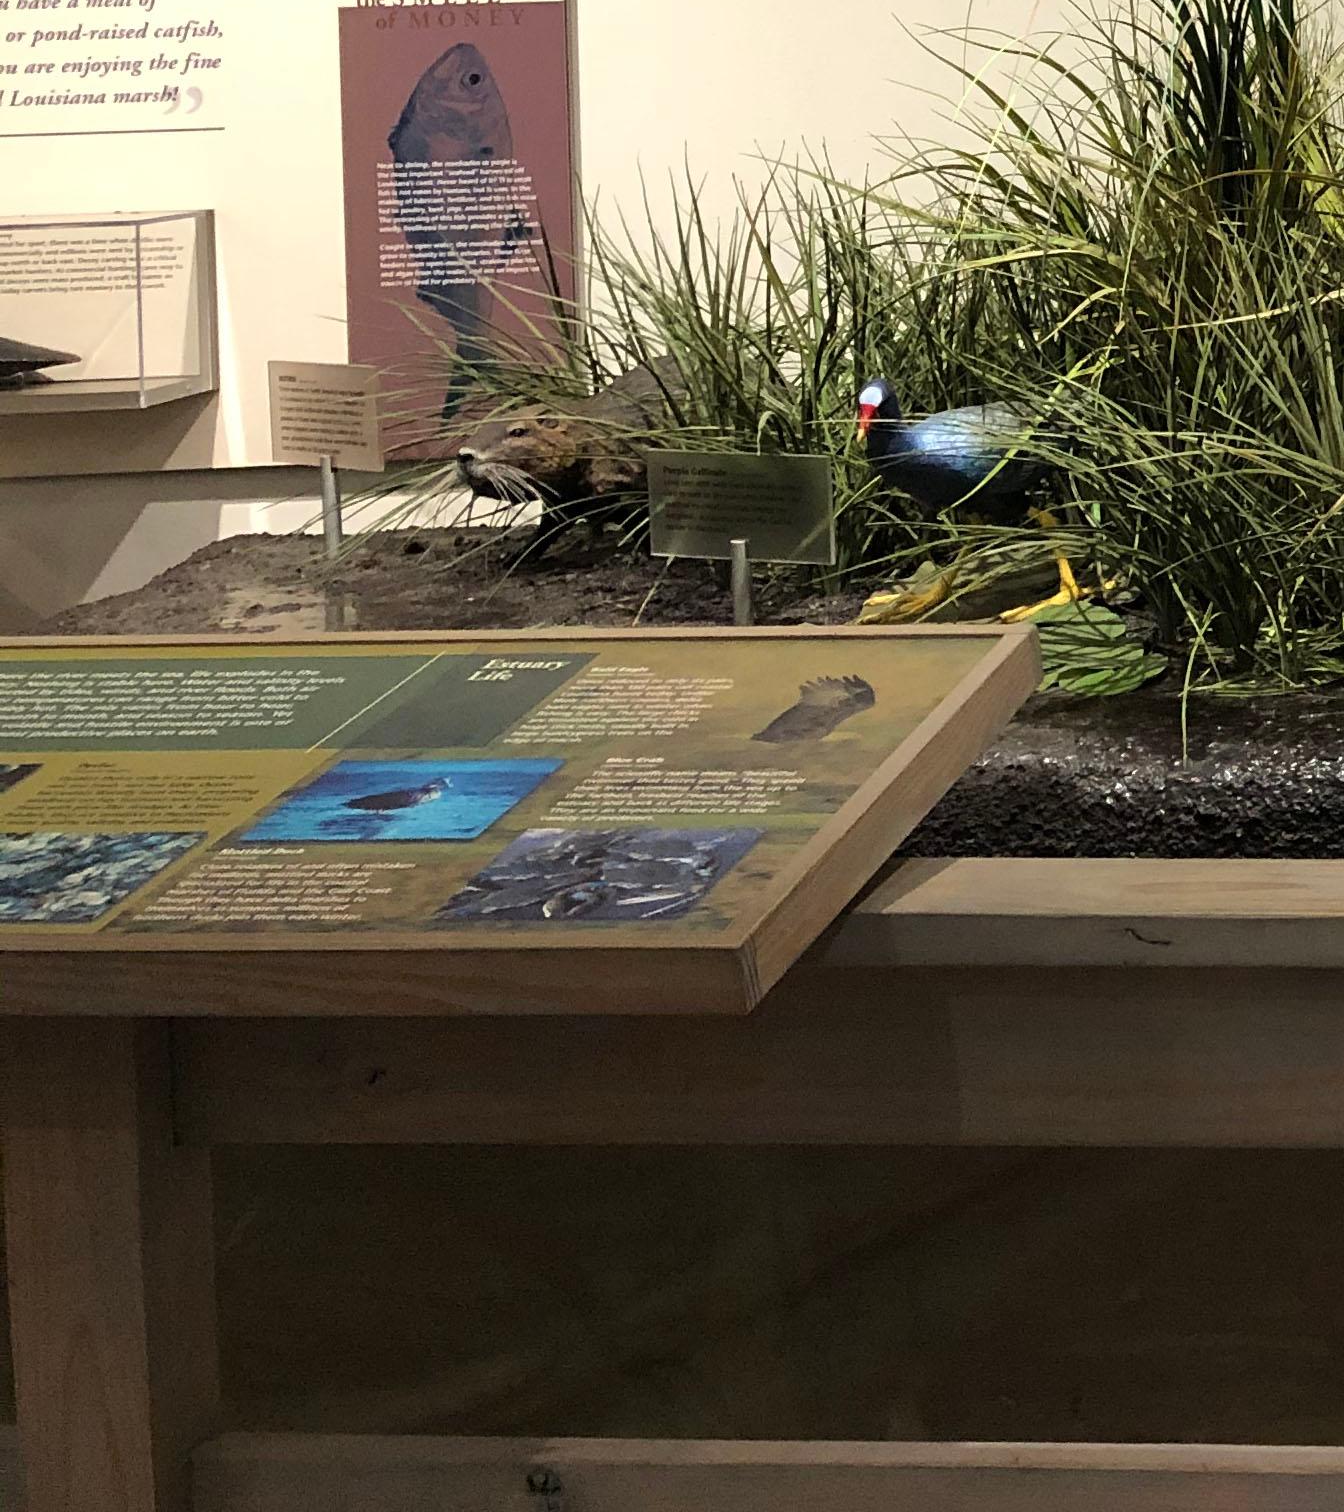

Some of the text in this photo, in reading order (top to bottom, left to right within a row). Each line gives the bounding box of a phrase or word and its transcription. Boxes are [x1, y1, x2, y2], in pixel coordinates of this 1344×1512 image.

[376, 9, 525, 29] of MONEY
[6, 20, 223, 47] or pond-raised catfish,
[24, 62, 55, 73] are
[62, 55, 143, 78] enjoying
[150, 53, 178, 70] the
[180, 52, 222, 75] fine
[10, 89, 106, 106] Louisiana
[483, 659, 571, 671] Estuary
[468, 670, 514, 681] Life
